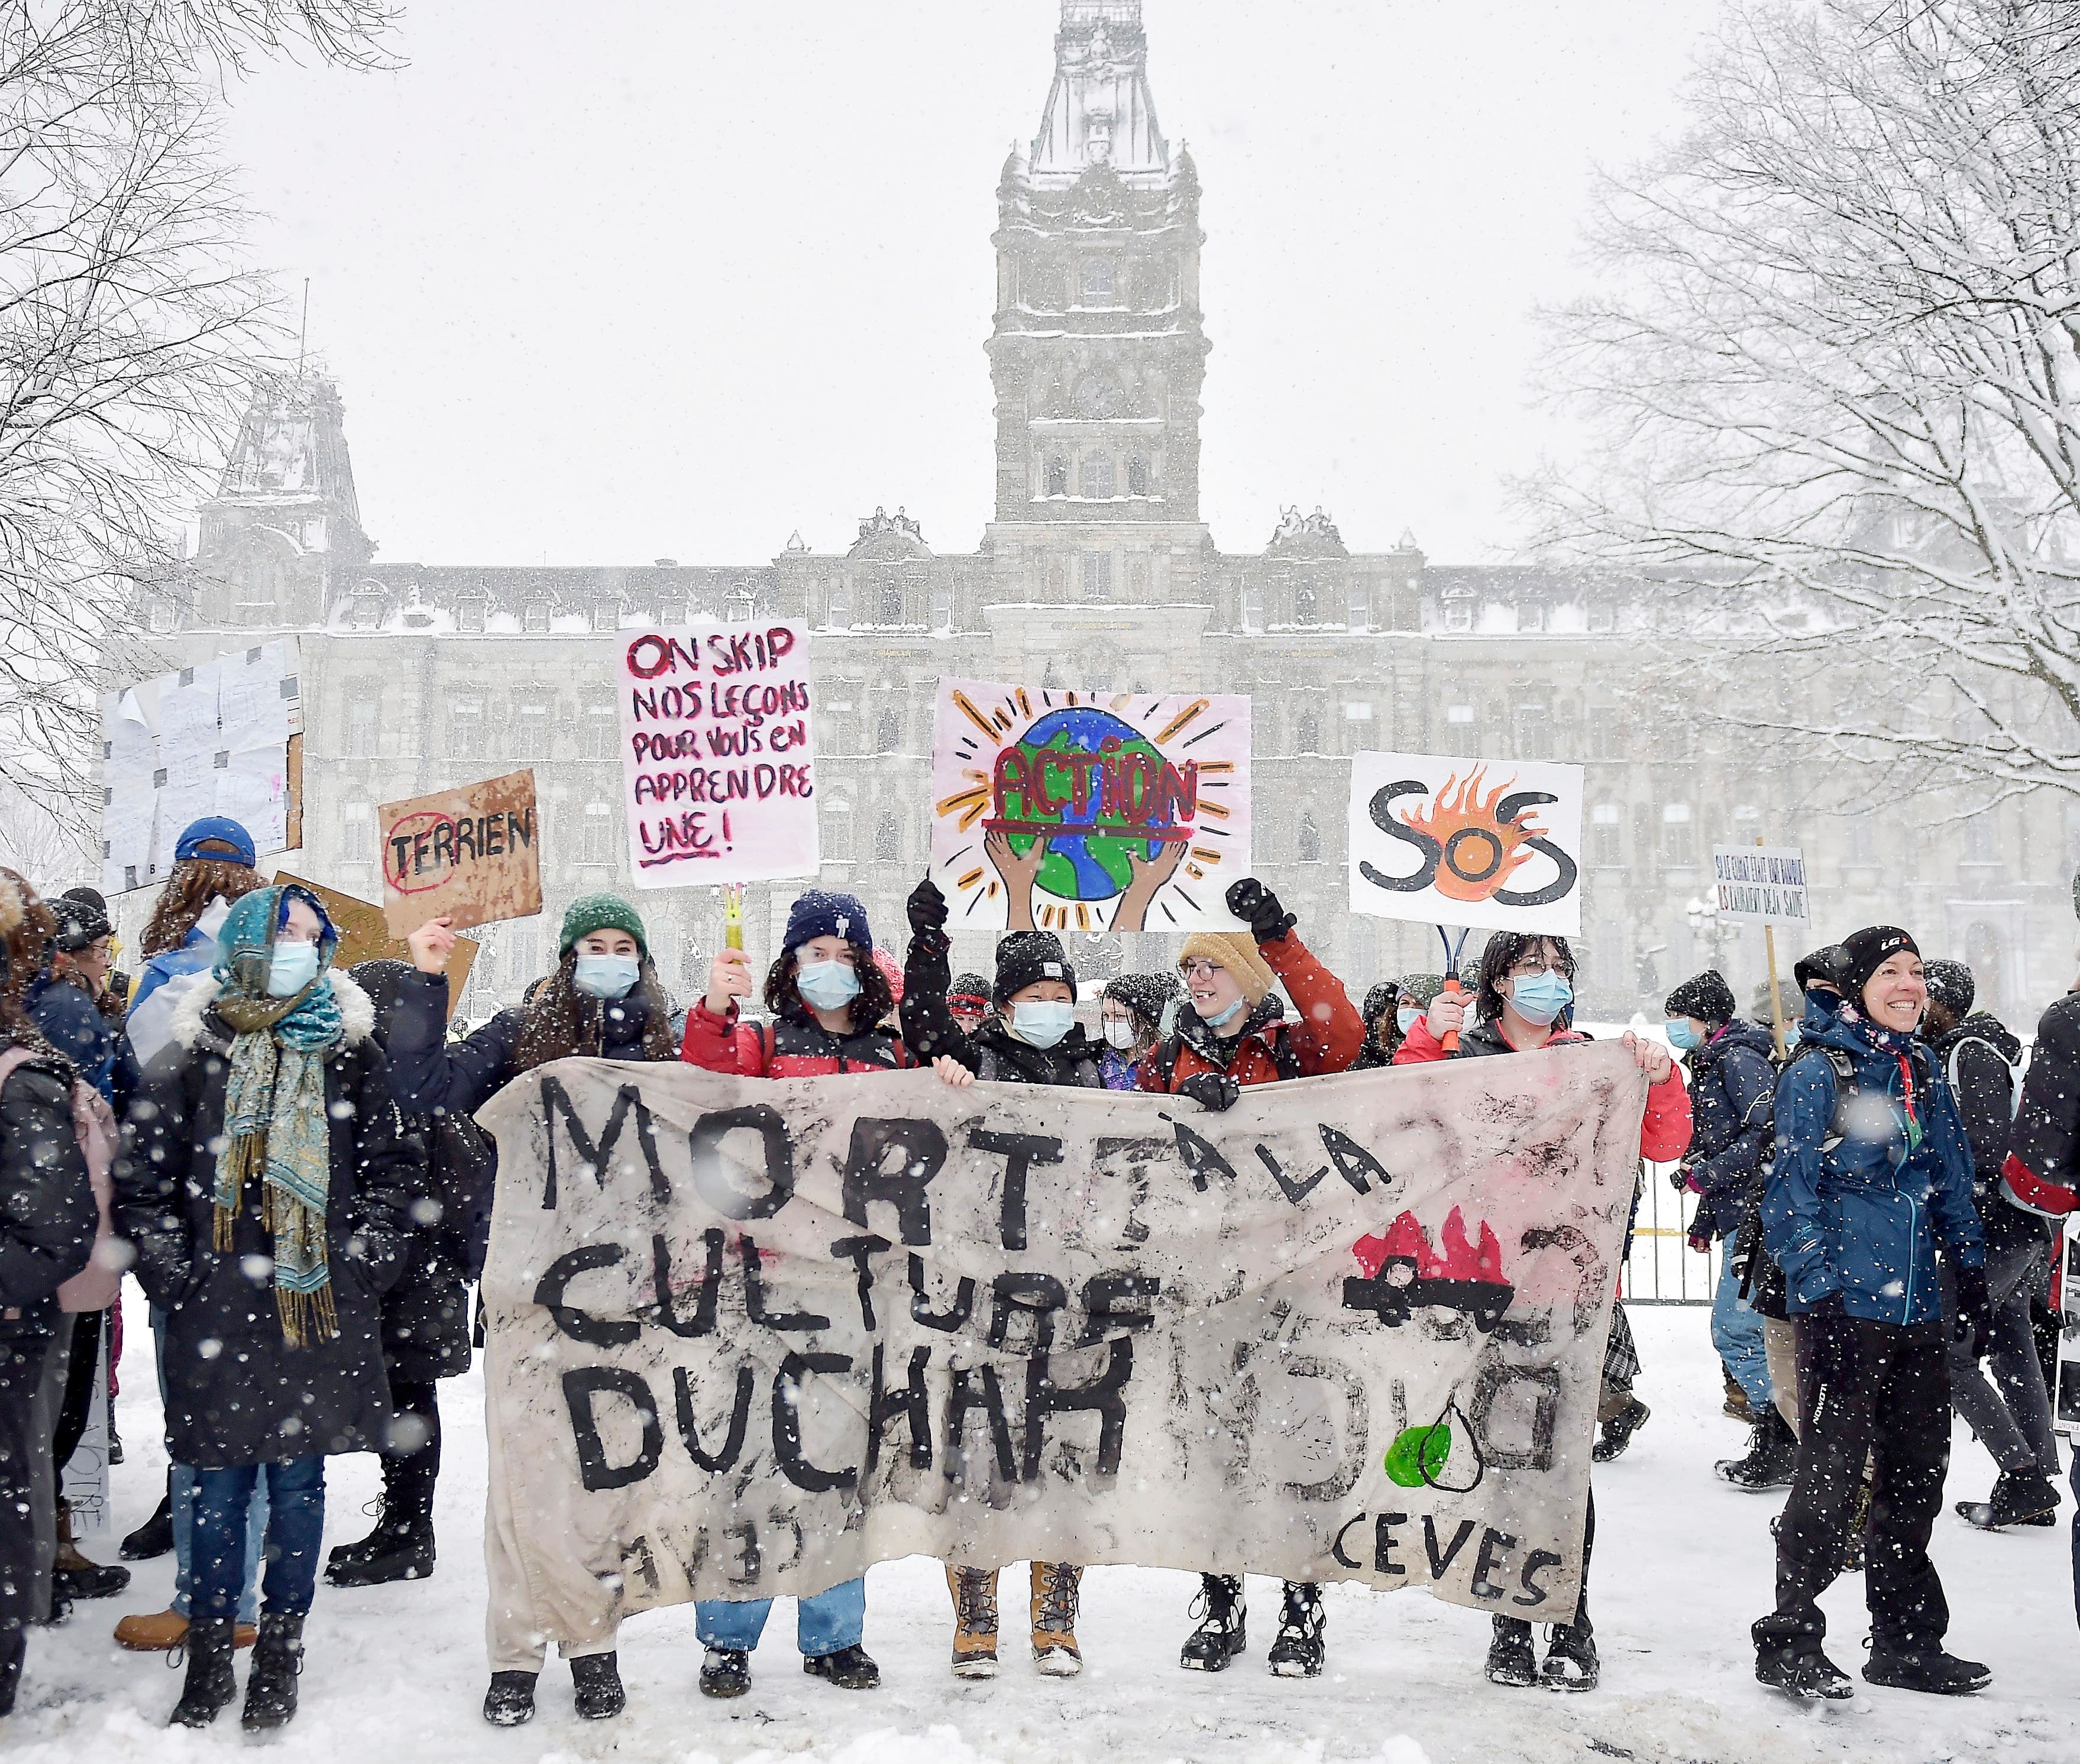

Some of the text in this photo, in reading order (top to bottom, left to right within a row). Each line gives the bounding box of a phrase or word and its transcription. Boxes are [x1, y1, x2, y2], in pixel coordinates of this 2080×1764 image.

[626, 627, 795, 679] ON SKIP
[632, 680, 810, 727] NOS LEÇONS
[633, 729, 701, 765] POUR
[707, 725, 763, 757] VOUS
[635, 763, 813, 805] APPRENDRE
[390, 808, 532, 879] TERRIEN
[1358, 779, 1577, 906] SOS
[541, 1076, 1064, 1250] MORT
[534, 1228, 1160, 1354] CULTURE
[1332, 1512, 1563, 1607] CEVES
